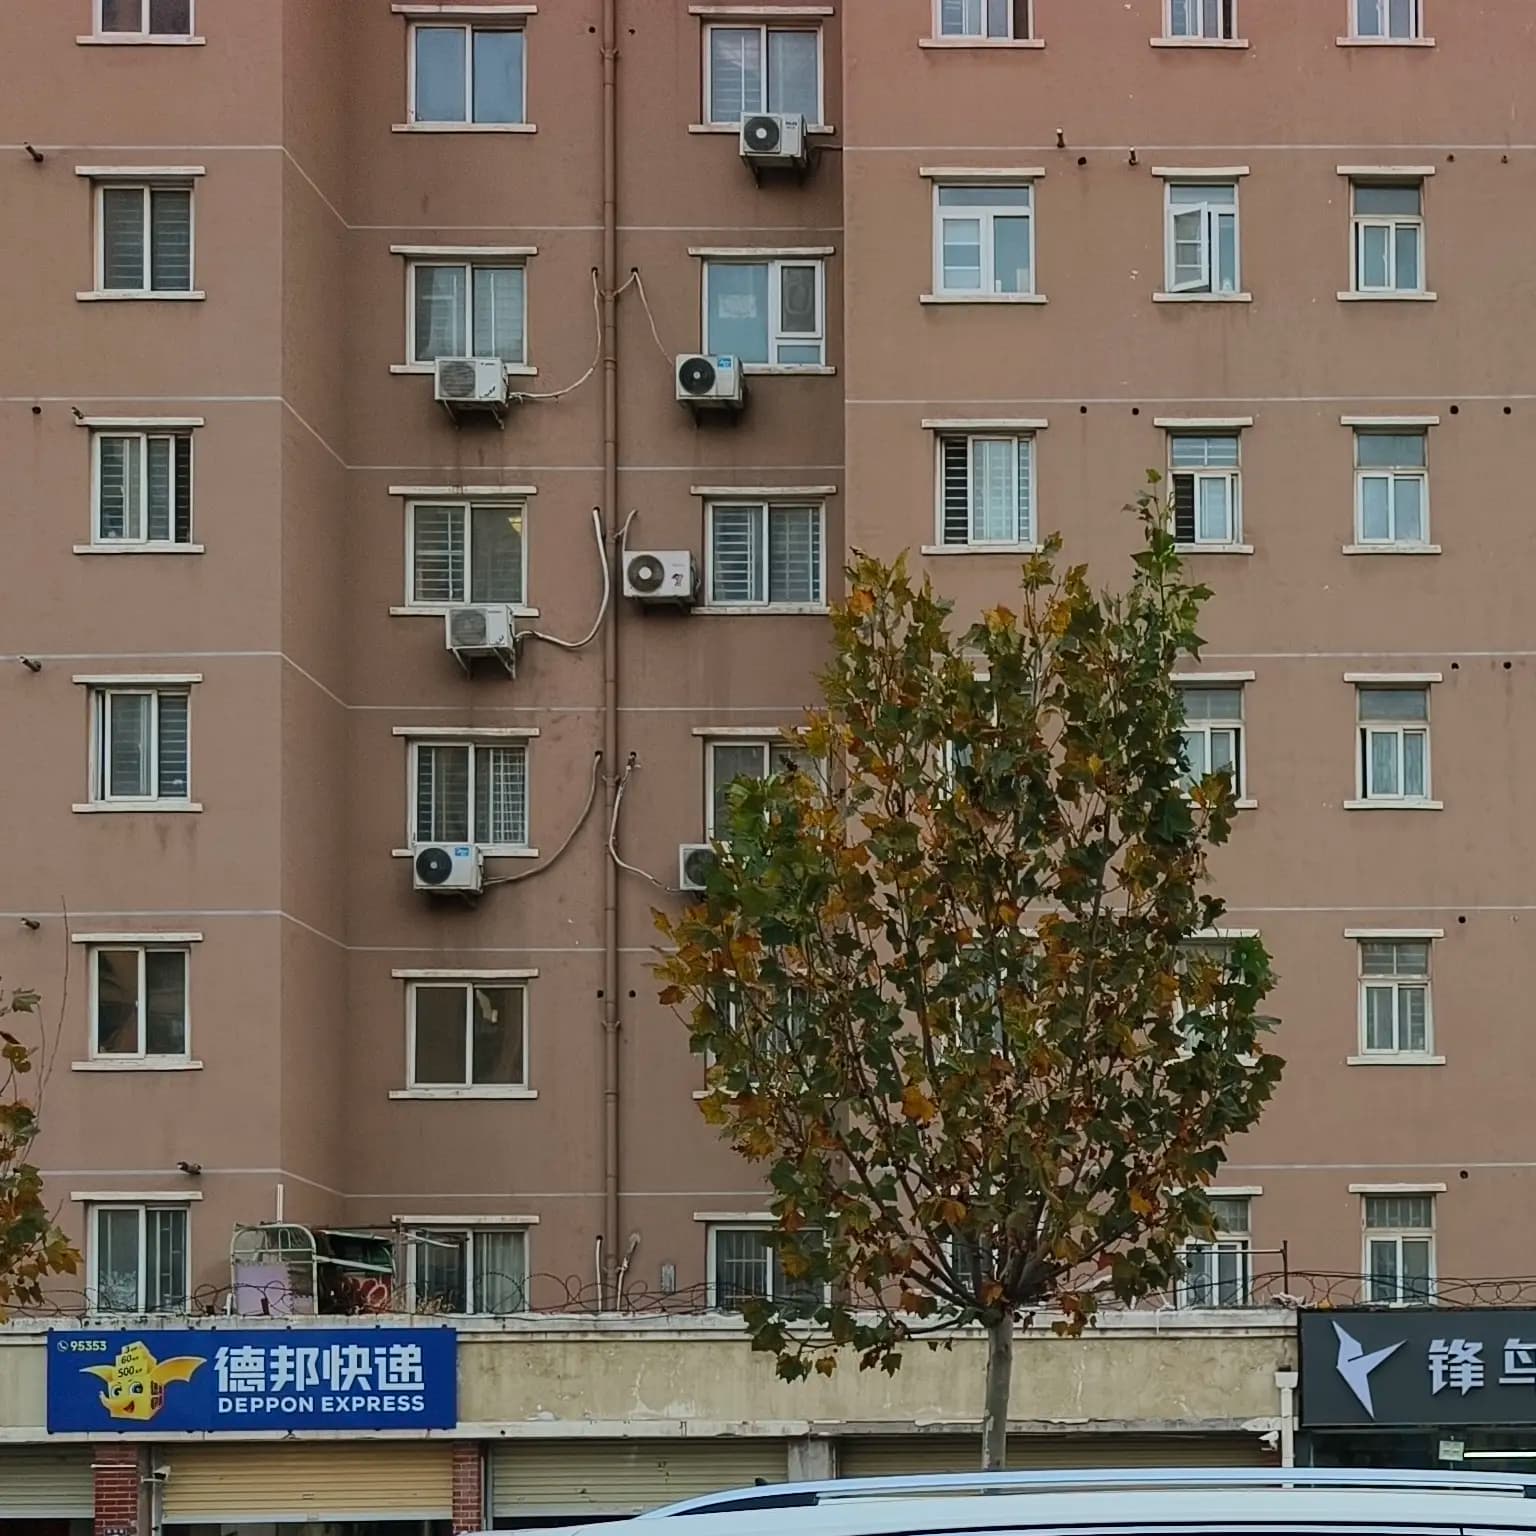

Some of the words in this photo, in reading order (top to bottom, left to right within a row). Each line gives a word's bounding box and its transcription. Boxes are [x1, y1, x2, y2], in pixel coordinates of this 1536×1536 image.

[70, 1340, 107, 1352] 95353
[213, 1343, 425, 1392] 德邦快递
[218, 1396, 314, 1413] DEPPON
[321, 1395, 425, 1412] EXPRESS
